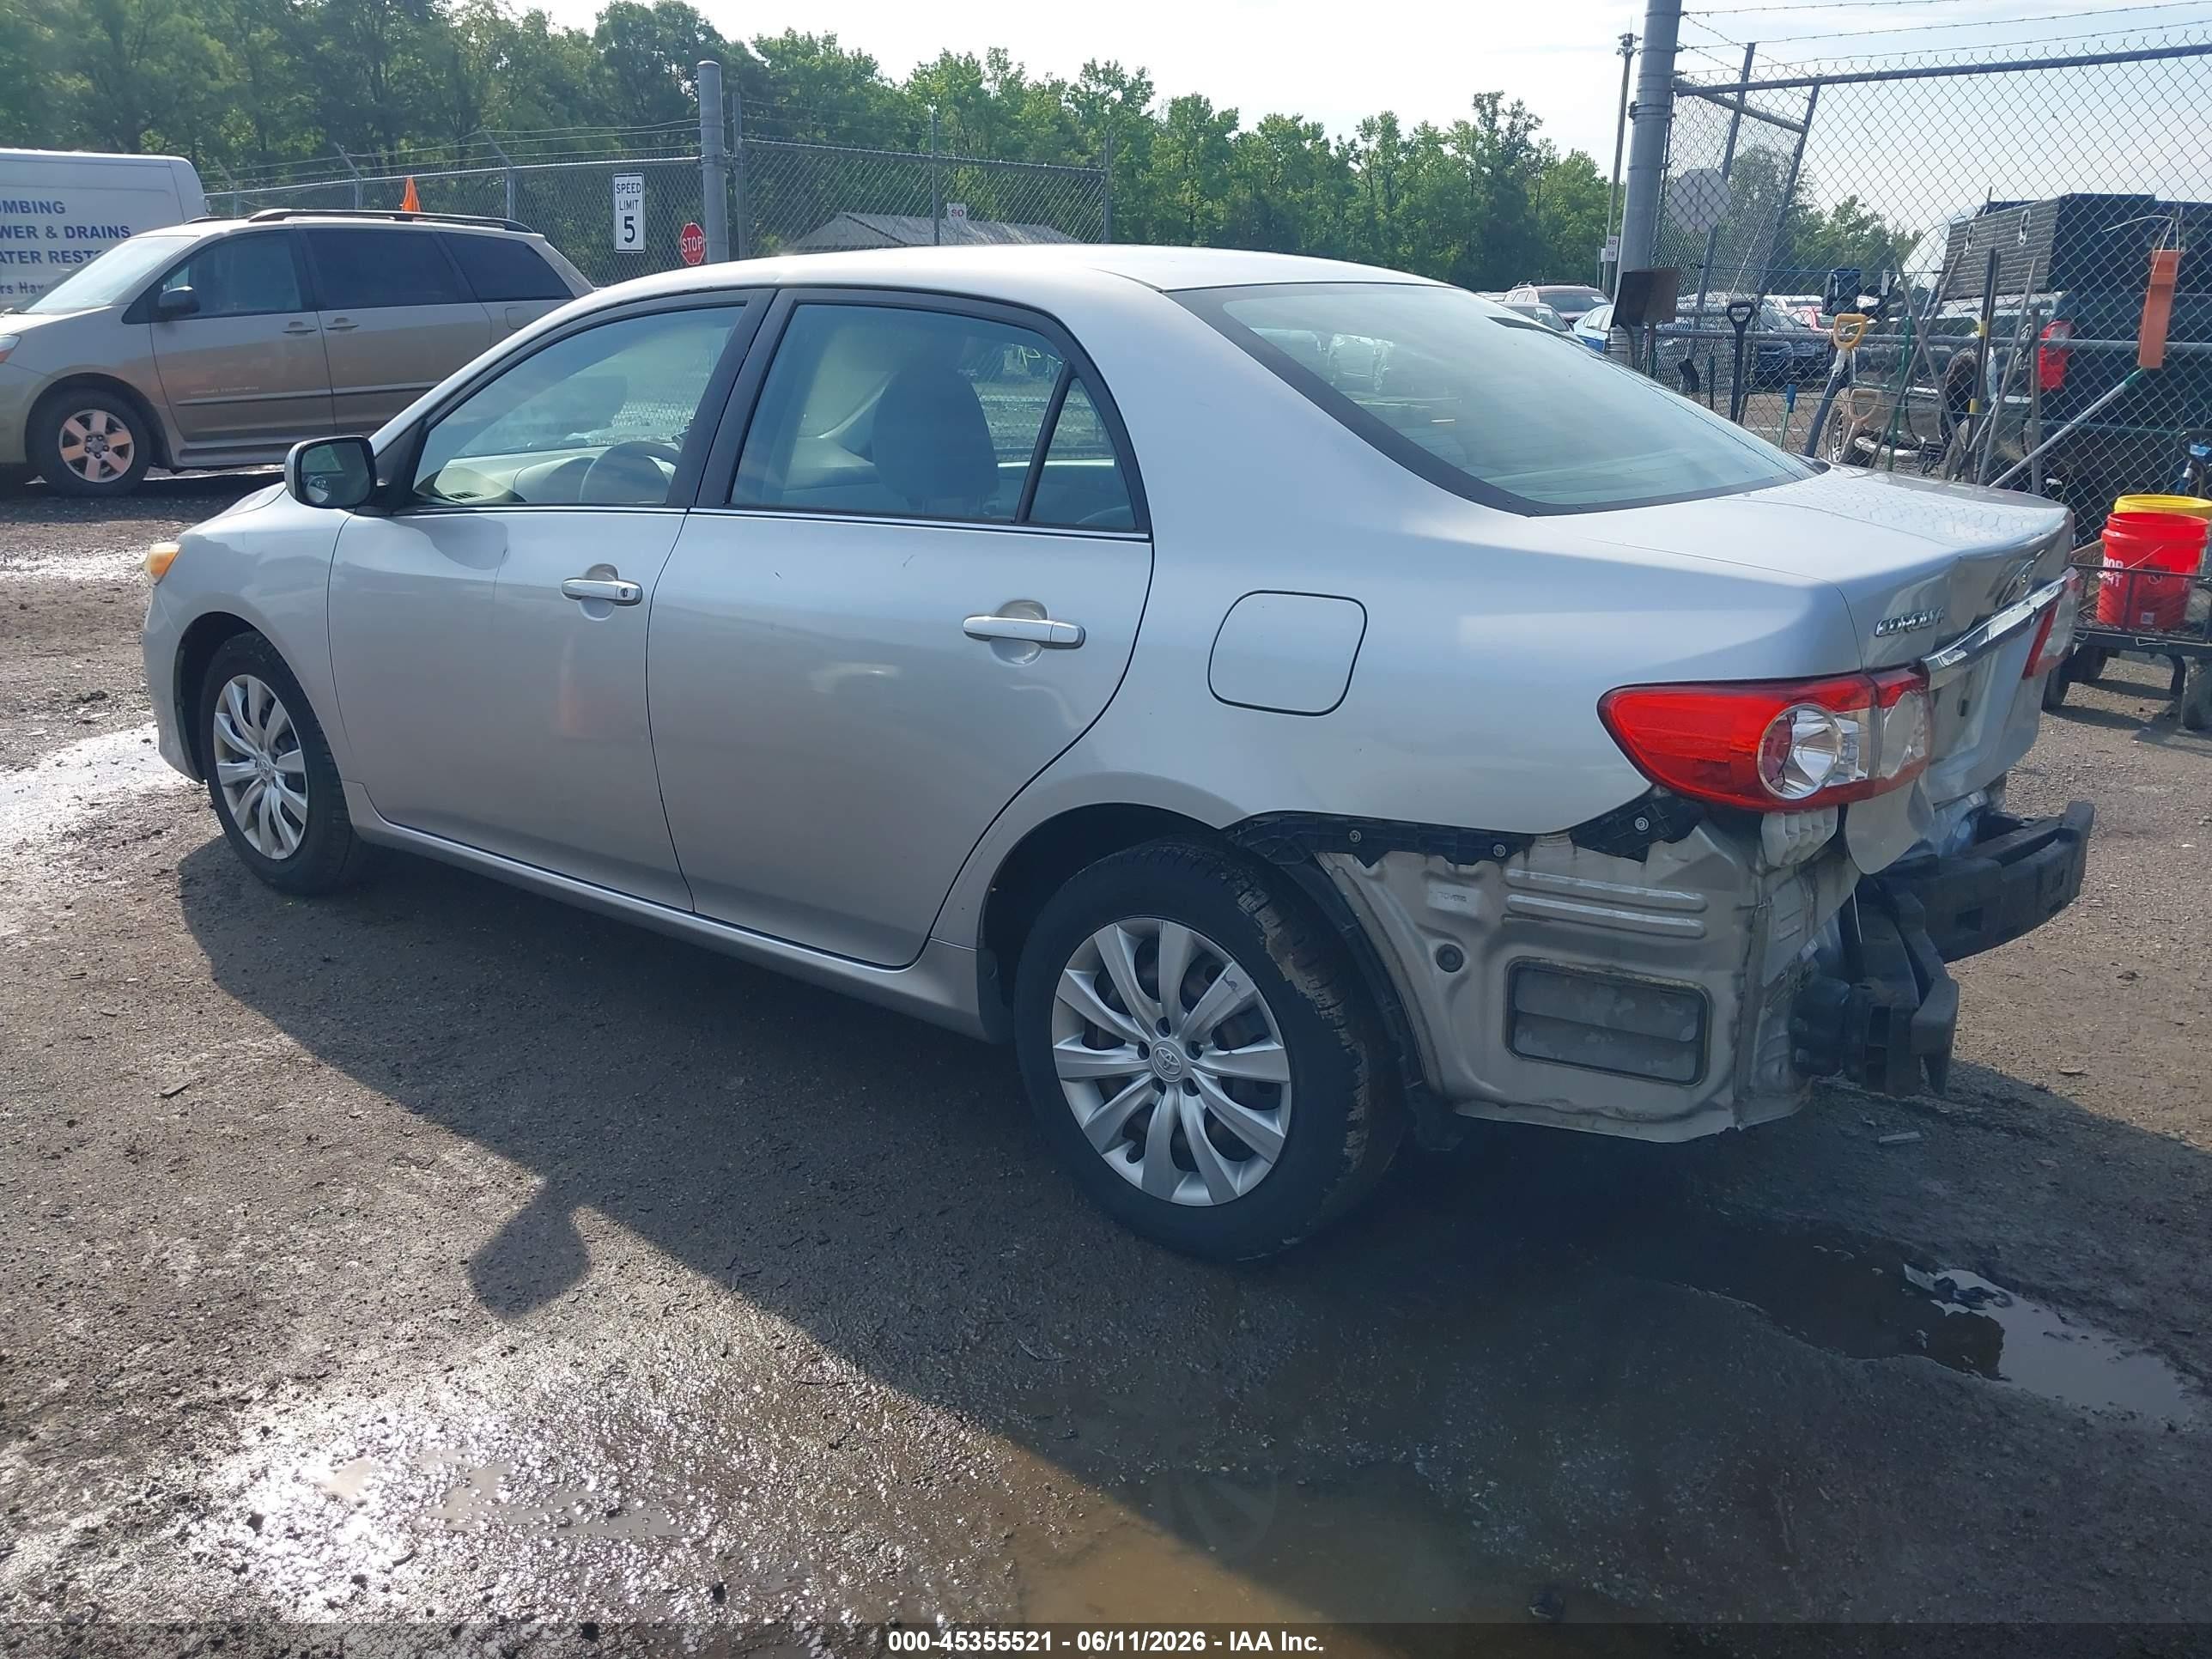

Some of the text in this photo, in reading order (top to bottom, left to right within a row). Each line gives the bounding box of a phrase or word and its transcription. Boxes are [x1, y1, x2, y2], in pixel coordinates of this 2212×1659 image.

[616, 182, 642, 194] SPEED
[618, 199, 640, 211] LIMIT
[46, 225, 58, 239] &
[64, 225, 131, 240] DRAINS
[623, 216, 635, 243] 5
[681, 235, 702, 253] STOP
[47, 250, 103, 264] REST
